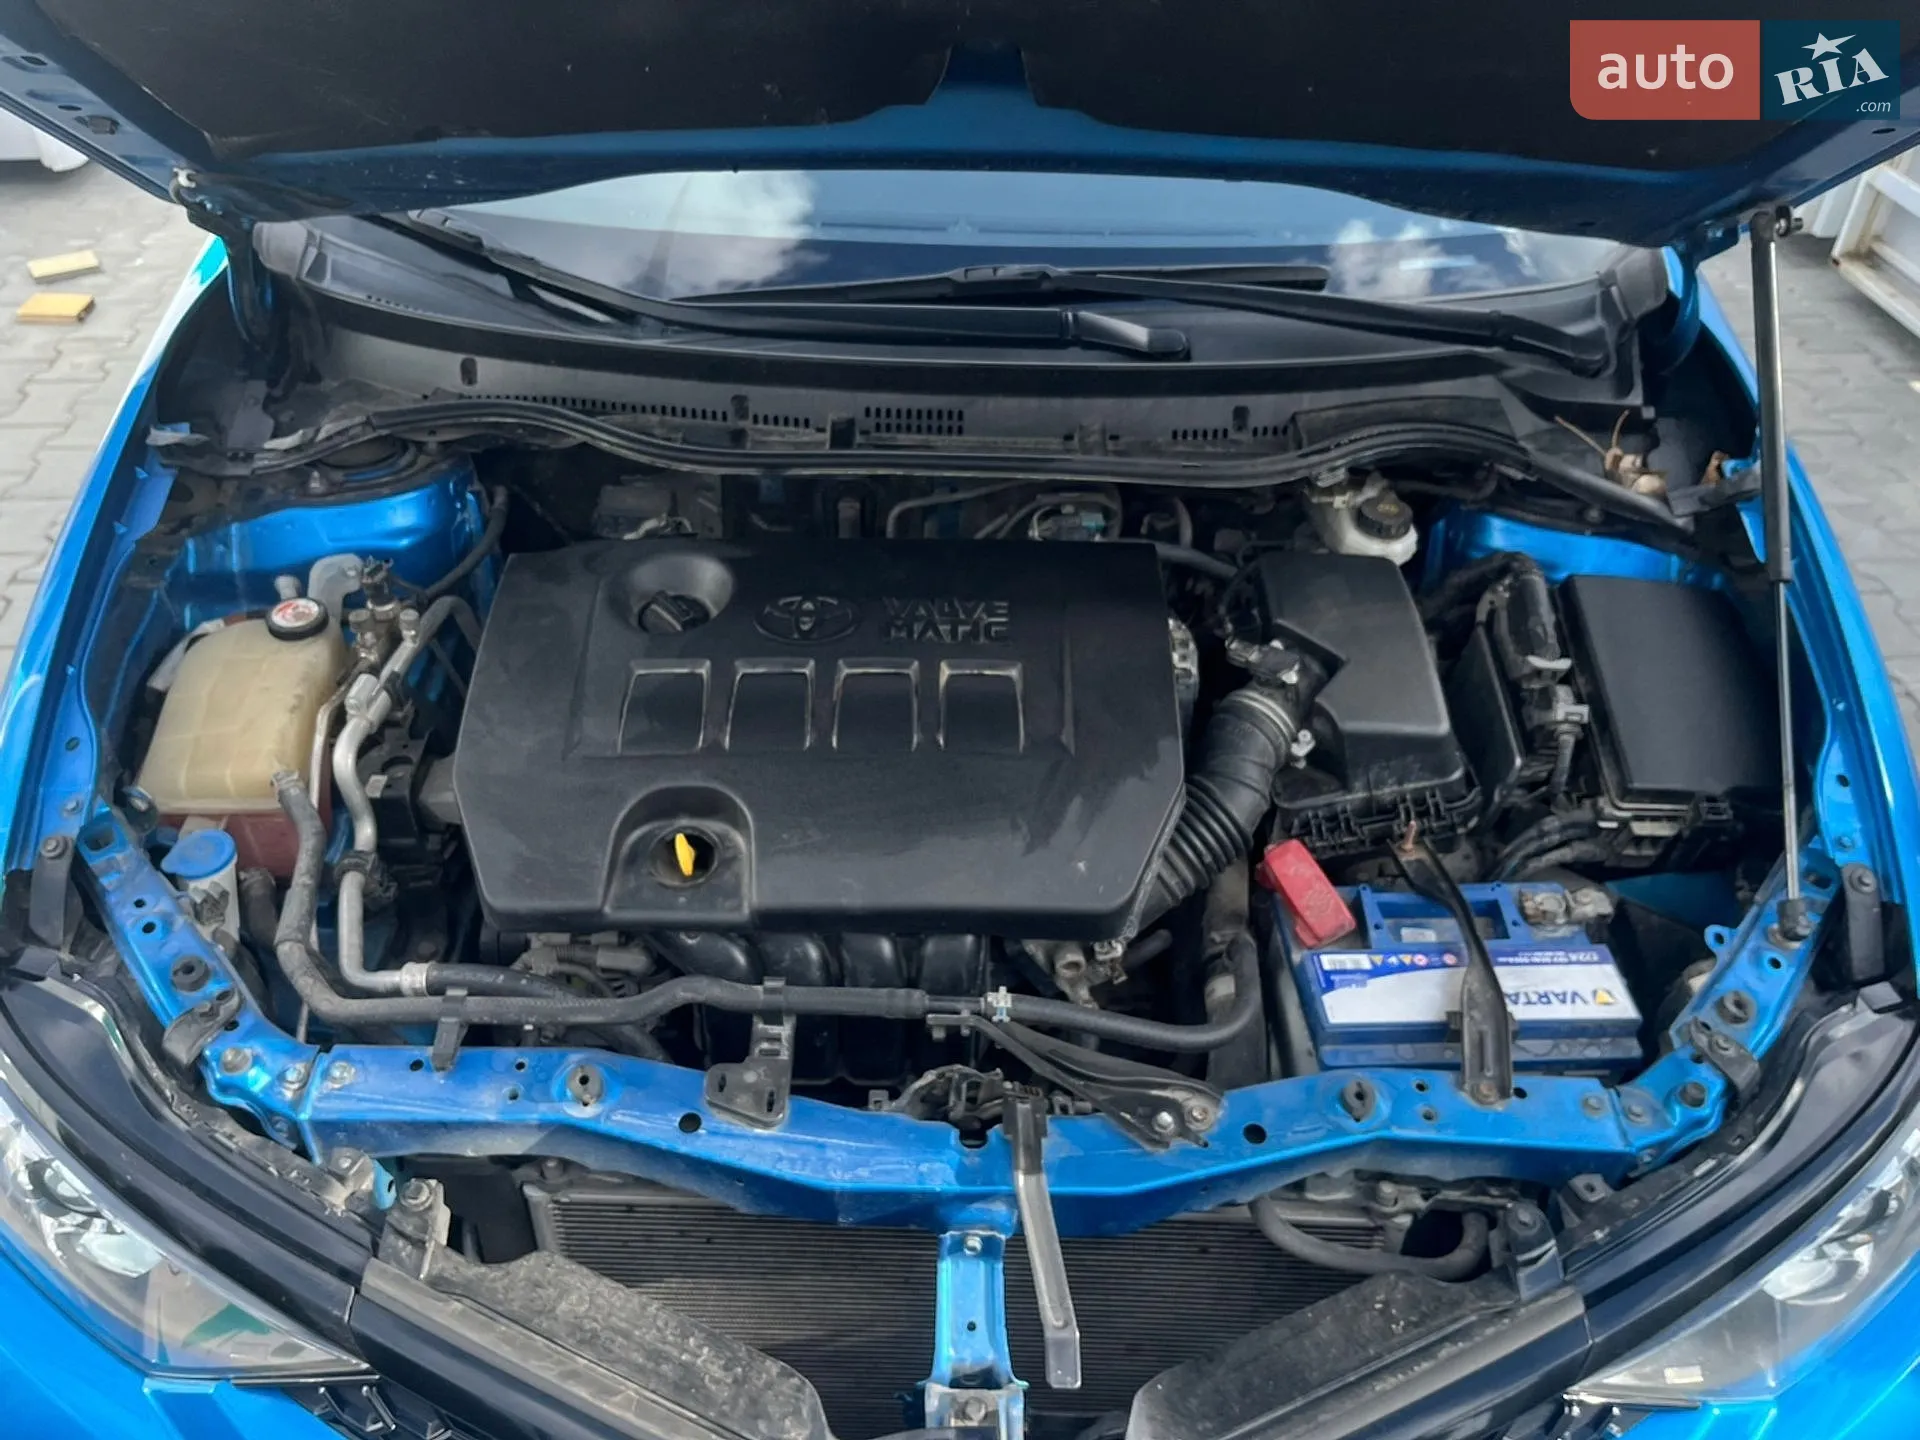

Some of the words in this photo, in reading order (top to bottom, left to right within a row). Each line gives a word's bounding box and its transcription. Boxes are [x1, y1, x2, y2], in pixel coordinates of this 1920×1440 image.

[881, 597, 1009, 621] VALVE
[883, 620, 1010, 644] MATIC
[1503, 990, 1588, 1006] VARTA
